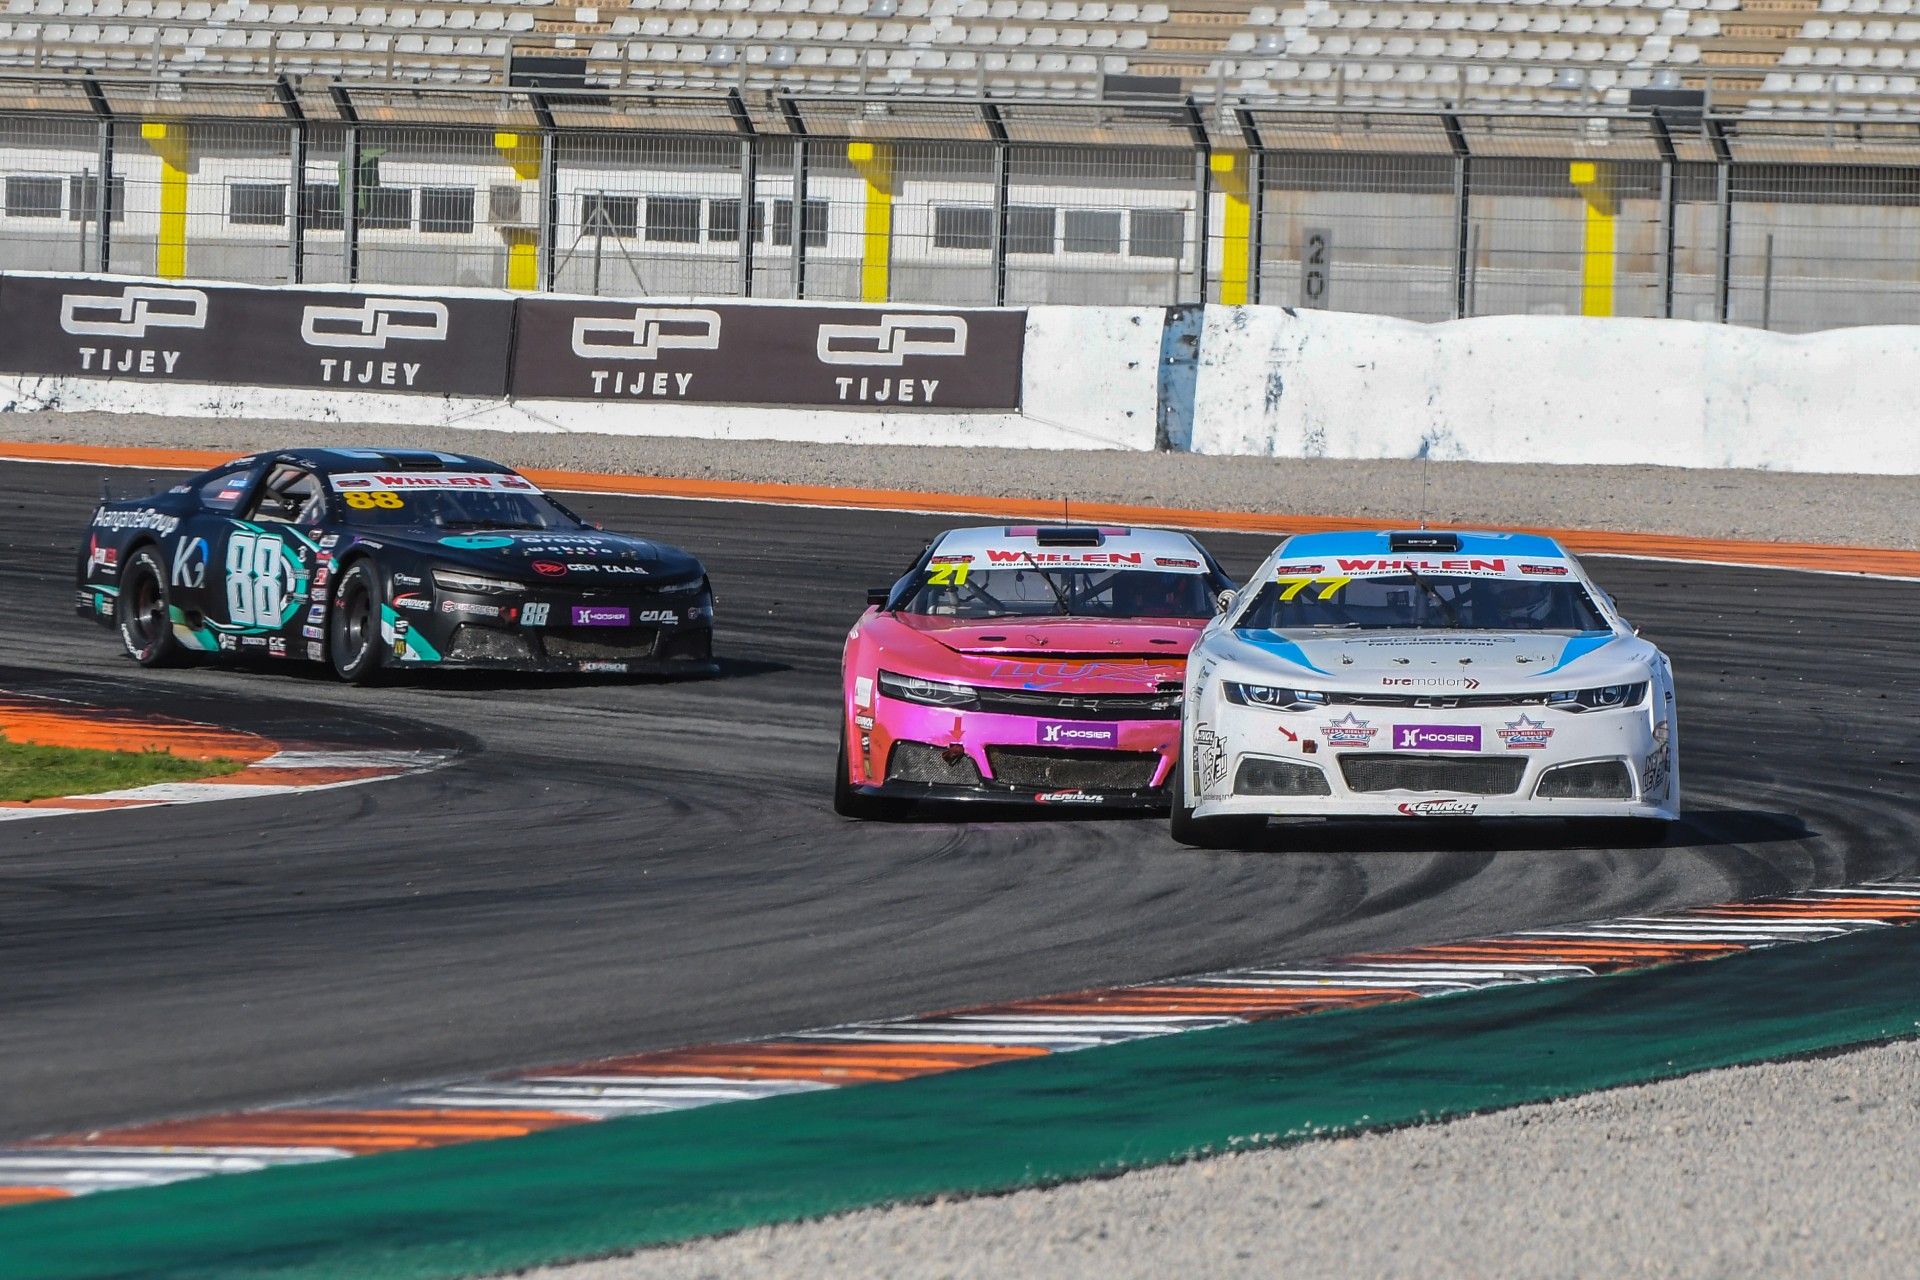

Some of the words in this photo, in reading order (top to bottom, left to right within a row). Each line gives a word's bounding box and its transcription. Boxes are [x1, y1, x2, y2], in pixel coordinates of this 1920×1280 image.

[1307, 234, 1324, 299] 20
[79, 347, 181, 374] TIJEY
[321, 358, 422, 386] TIJEY
[591, 371, 693, 396] TIJEY
[836, 377, 940, 402] TIJEY
[373, 475, 492, 486] WHELEN
[343, 491, 404, 509] 88
[986, 550, 1142, 564] WHELEN
[1337, 559, 1506, 572] WHELEN
[226, 530, 283, 629] 88
[927, 562, 969, 585] 21
[1276, 577, 1351, 601] 77
[520, 603, 550, 627] 88
[589, 613, 626, 621] HOOSIER
[1382, 676, 1467, 687] bremotion
[1060, 730, 1111, 739] HOOSIER
[1419, 733, 1474, 743] HOOSIER
[1404, 802, 1477, 812] KENNOL
